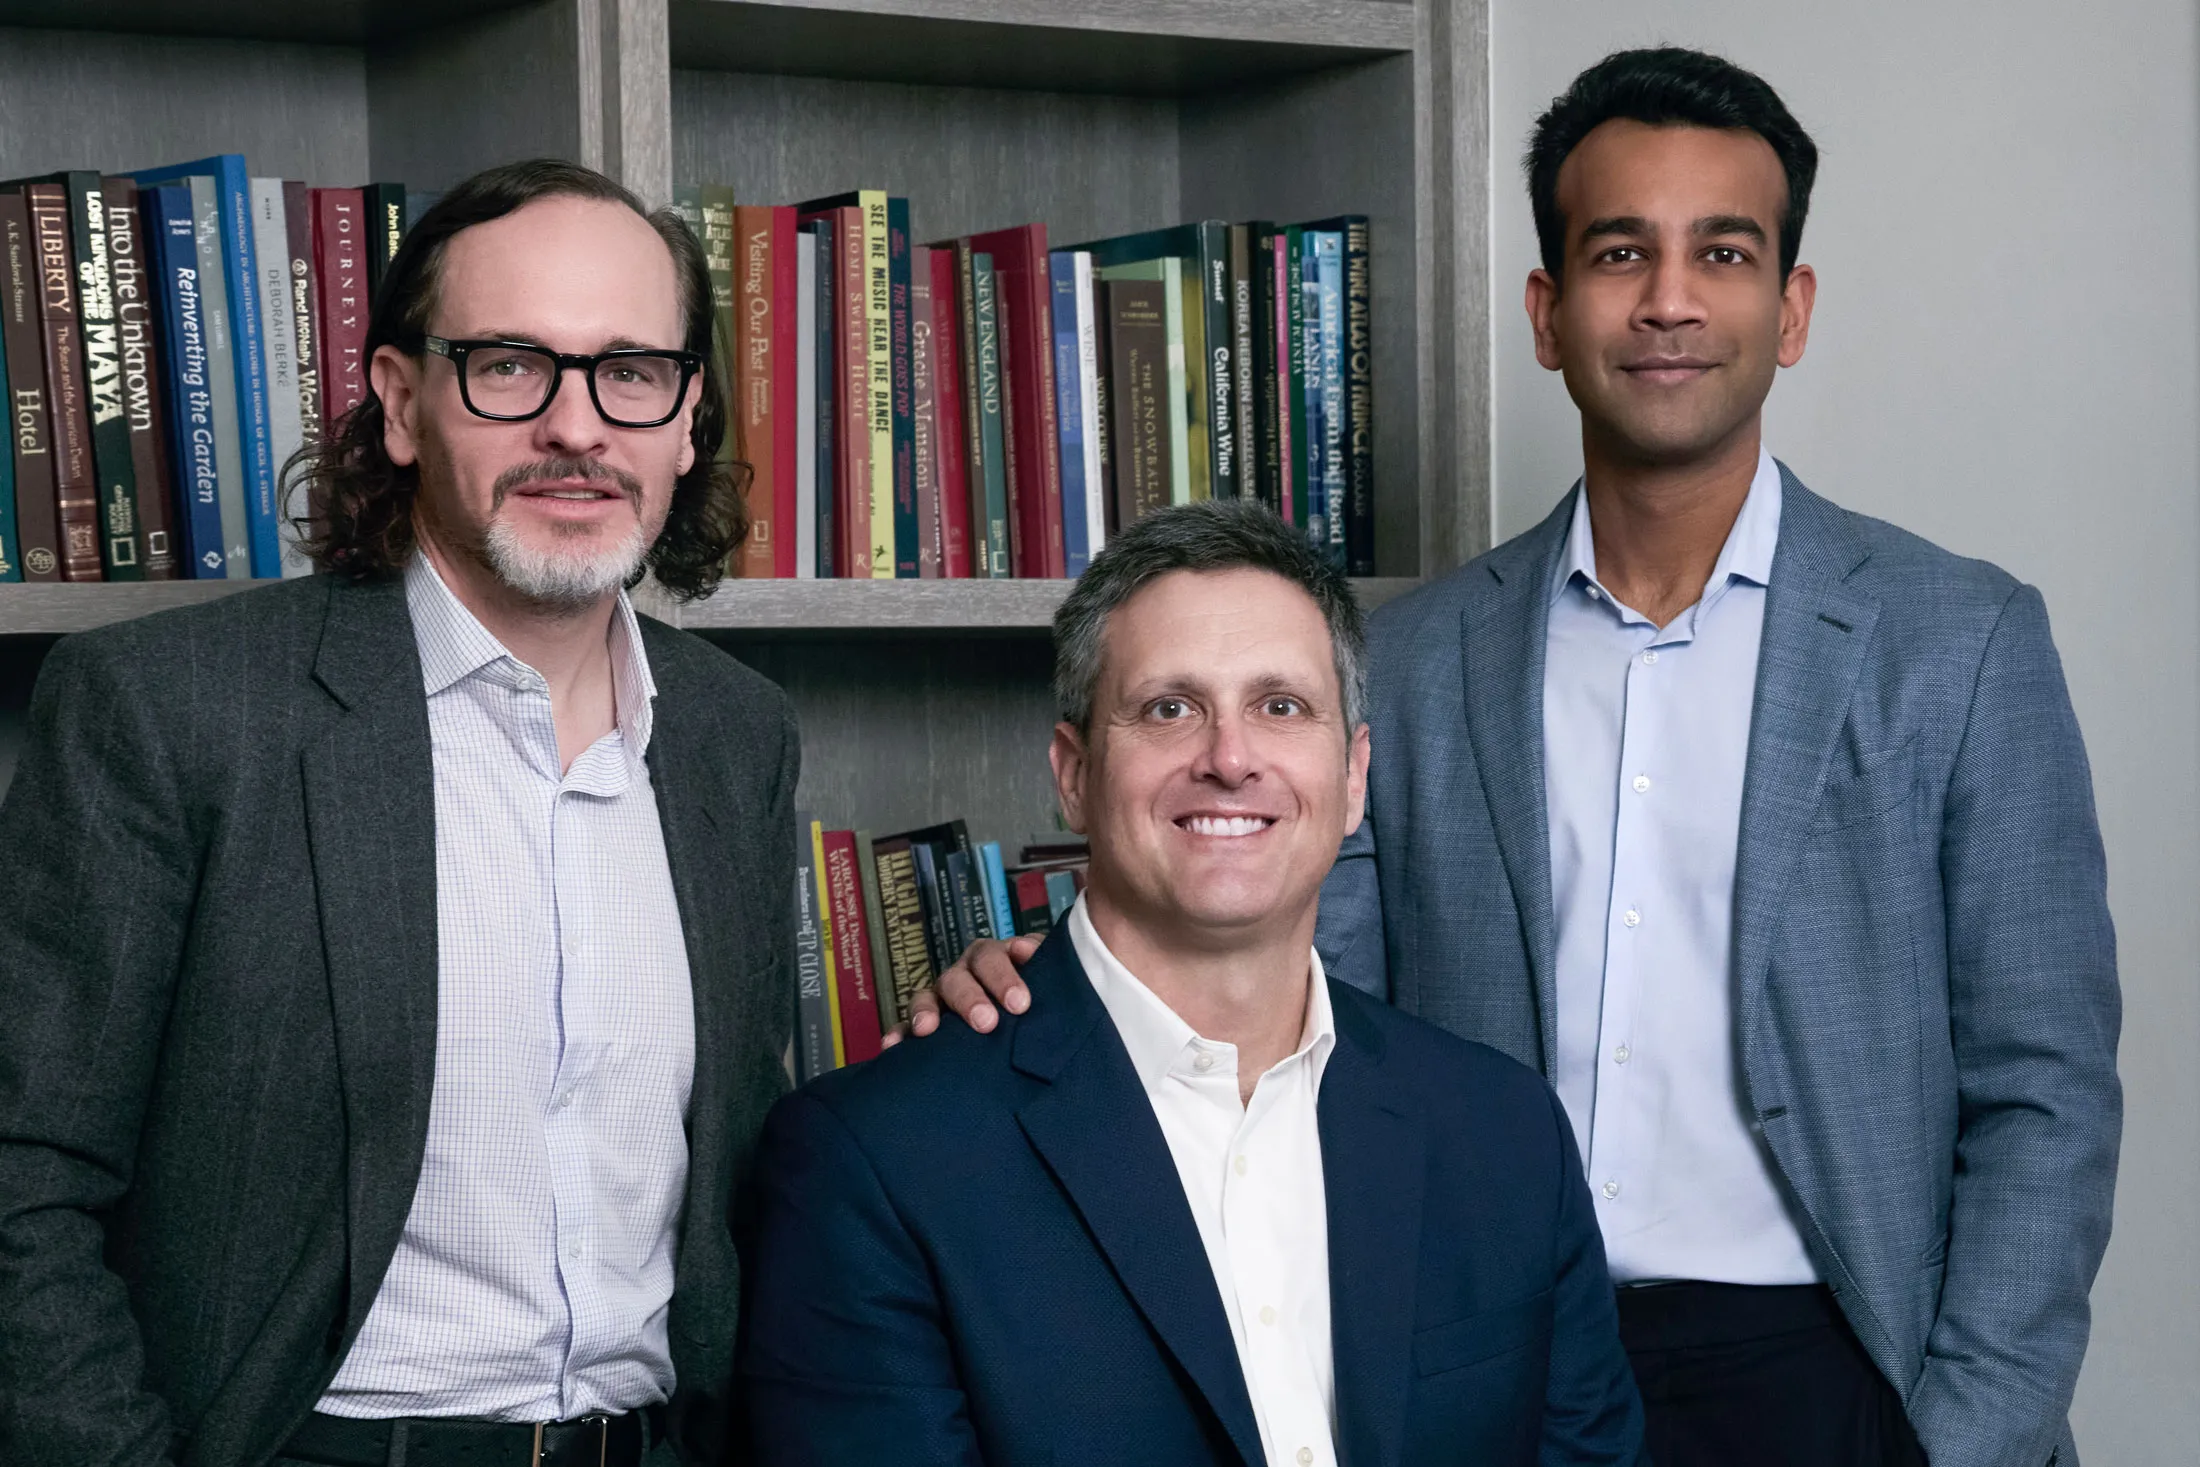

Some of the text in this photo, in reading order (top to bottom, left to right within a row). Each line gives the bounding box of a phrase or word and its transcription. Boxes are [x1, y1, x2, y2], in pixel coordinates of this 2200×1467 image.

[387, 203, 400, 230] John
[1348, 222, 1369, 253] THE
[40, 215, 71, 313] LIBERTY
[86, 191, 115, 320] LOST KINGDOMS
[336, 204, 357, 329] JOURNEY
[1212, 260, 1225, 304] Sunset
[1348, 256, 1369, 298] WINE
[80, 261, 98, 319] OF THE
[108, 206, 153, 432] Into the Unknown
[267, 269, 286, 339] DEBORAH
[293, 279, 309, 313] Rand
[746, 230, 769, 371] Visiting Our Past
[871, 203, 891, 434] SEE THE MUSIC HEAR THE DANCE
[892, 282, 907, 308] THE
[963, 275, 974, 326] ENGLAND
[1237, 280, 1251, 334] KOREA
[57, 326, 69, 345] The
[296, 315, 313, 366] McNally
[848, 225, 866, 420] HOME SWEET HOME
[893, 309, 908, 355] WORLD
[976, 269, 1001, 415] NEW ENGLAND
[1083, 323, 1095, 362] WINE
[1350, 301, 1370, 350] ATLAS
[61, 374, 75, 391] and
[85, 323, 124, 425] MAYA
[912, 320, 931, 390] Gracie
[1239, 337, 1254, 403] REBORN
[1350, 351, 1372, 381] OF
[63, 392, 76, 406] the
[177, 267, 217, 503] Reinventing the Garden
[896, 391, 910, 418] POP
[1214, 347, 1234, 477] California Wine
[1323, 283, 1345, 545] America From the Road
[16, 388, 46, 456] Hotel
[65, 407, 81, 447] American
[255, 427, 265, 439] OF
[914, 398, 933, 489] Mansion
[1142, 362, 1160, 503] THE SNOWBALL
[876, 855, 899, 906] MODERN
[888, 850, 920, 917] HUGH
[828, 850, 854, 970] WINES of the World
[838, 847, 870, 1001] LAROUSSE Dictionary of
[796, 929, 818, 950] UP
[884, 907, 911, 995] ENCYCLOPEDIA
[798, 952, 821, 999] CLOSE
